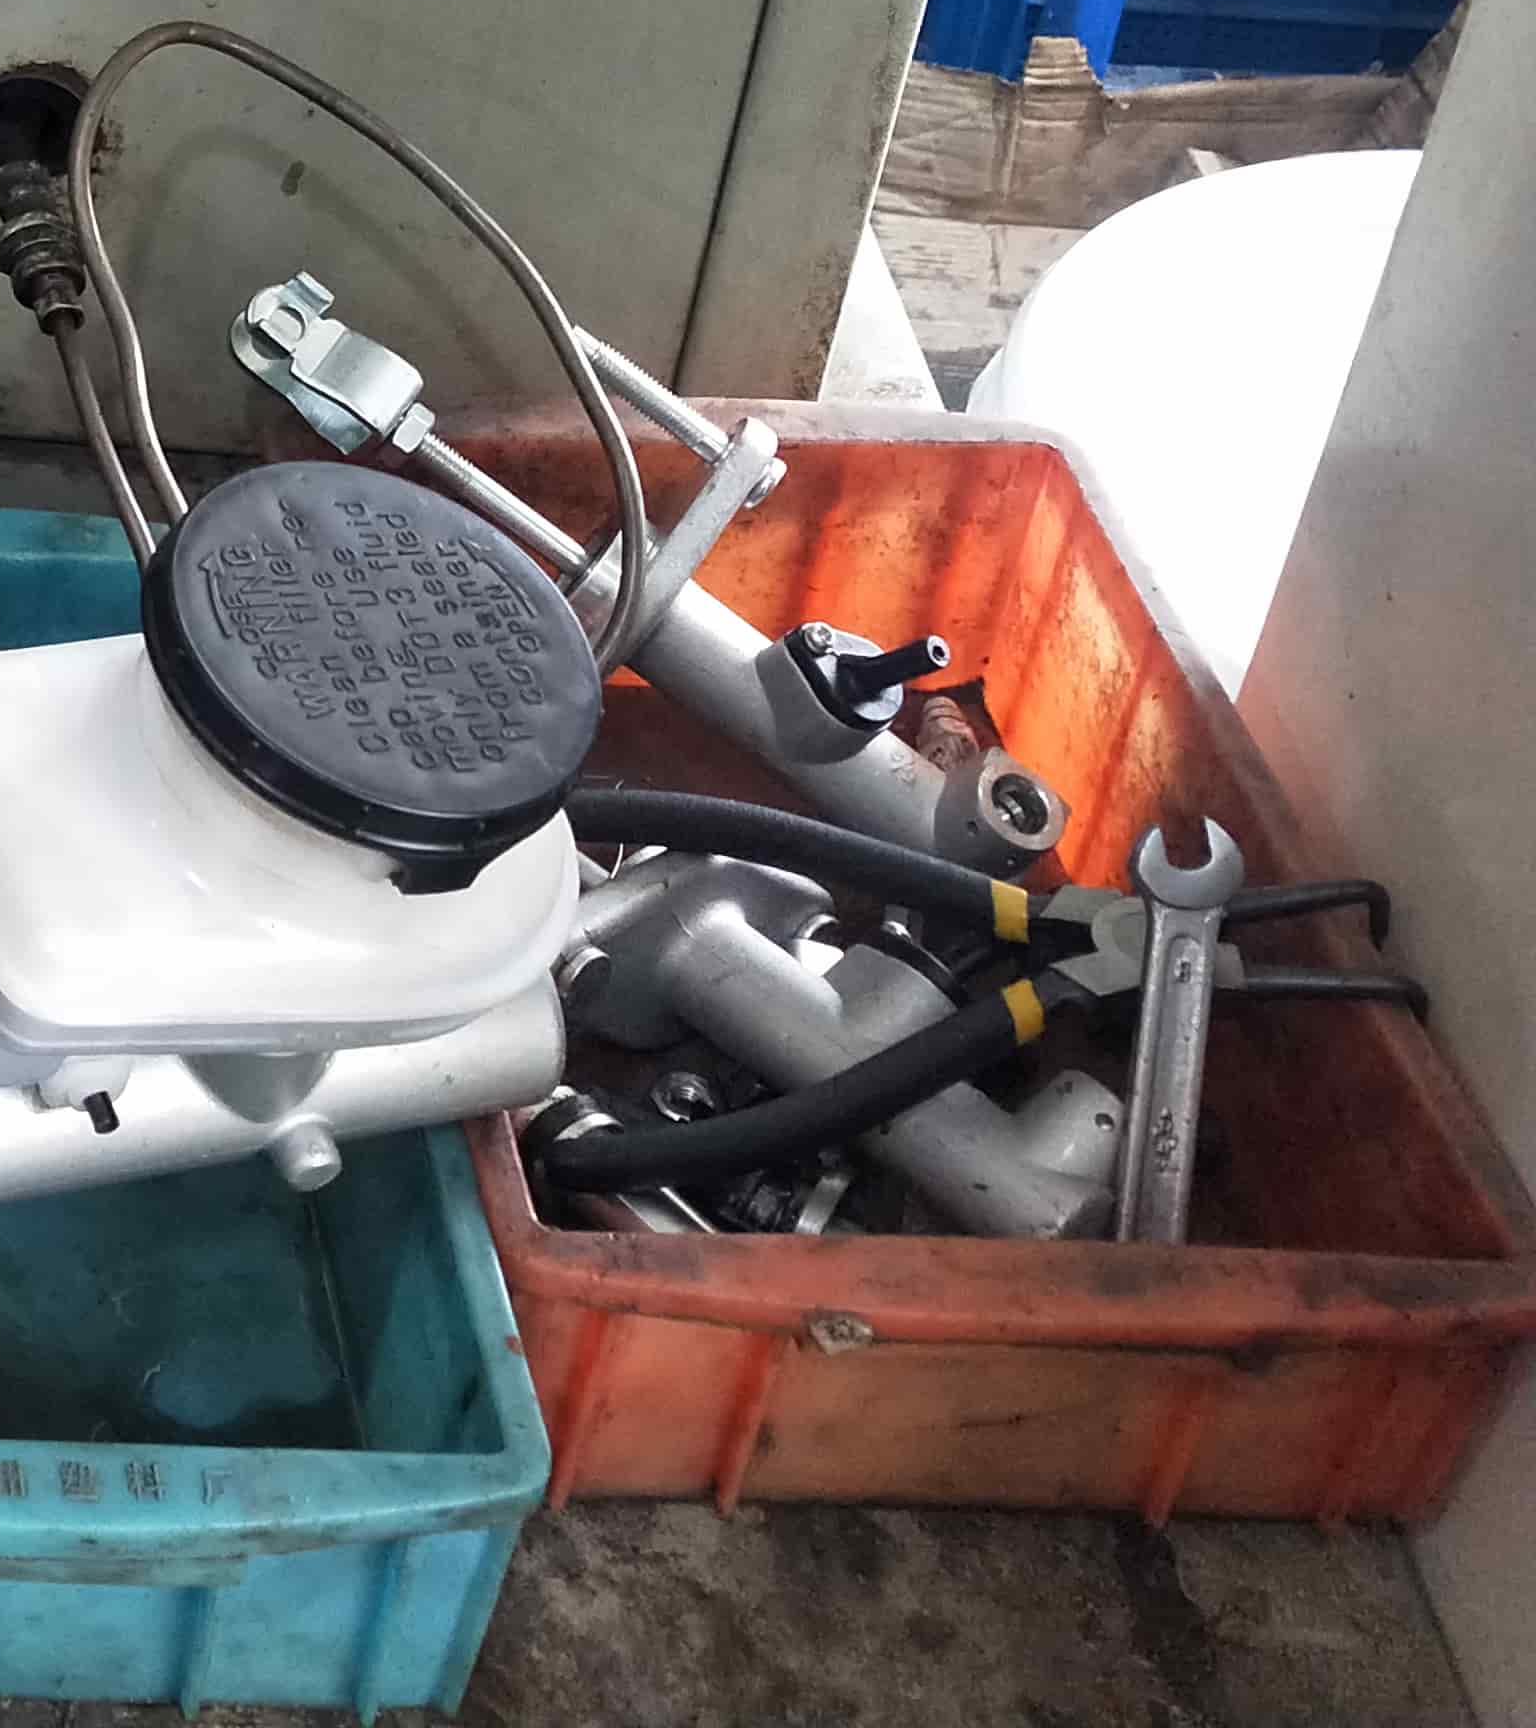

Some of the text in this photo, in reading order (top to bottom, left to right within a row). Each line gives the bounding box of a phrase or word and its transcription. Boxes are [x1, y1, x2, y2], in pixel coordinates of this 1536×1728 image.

[220, 545, 336, 719] WARNING
[262, 541, 391, 754] Clean filler
[312, 572, 390, 682] before
[334, 547, 379, 607] Use
[335, 501, 507, 763] only DOT 3 fluid
[376, 513, 535, 742] from a sealed
[485, 584, 541, 655] OPEN
[390, 709, 437, 770] cap
